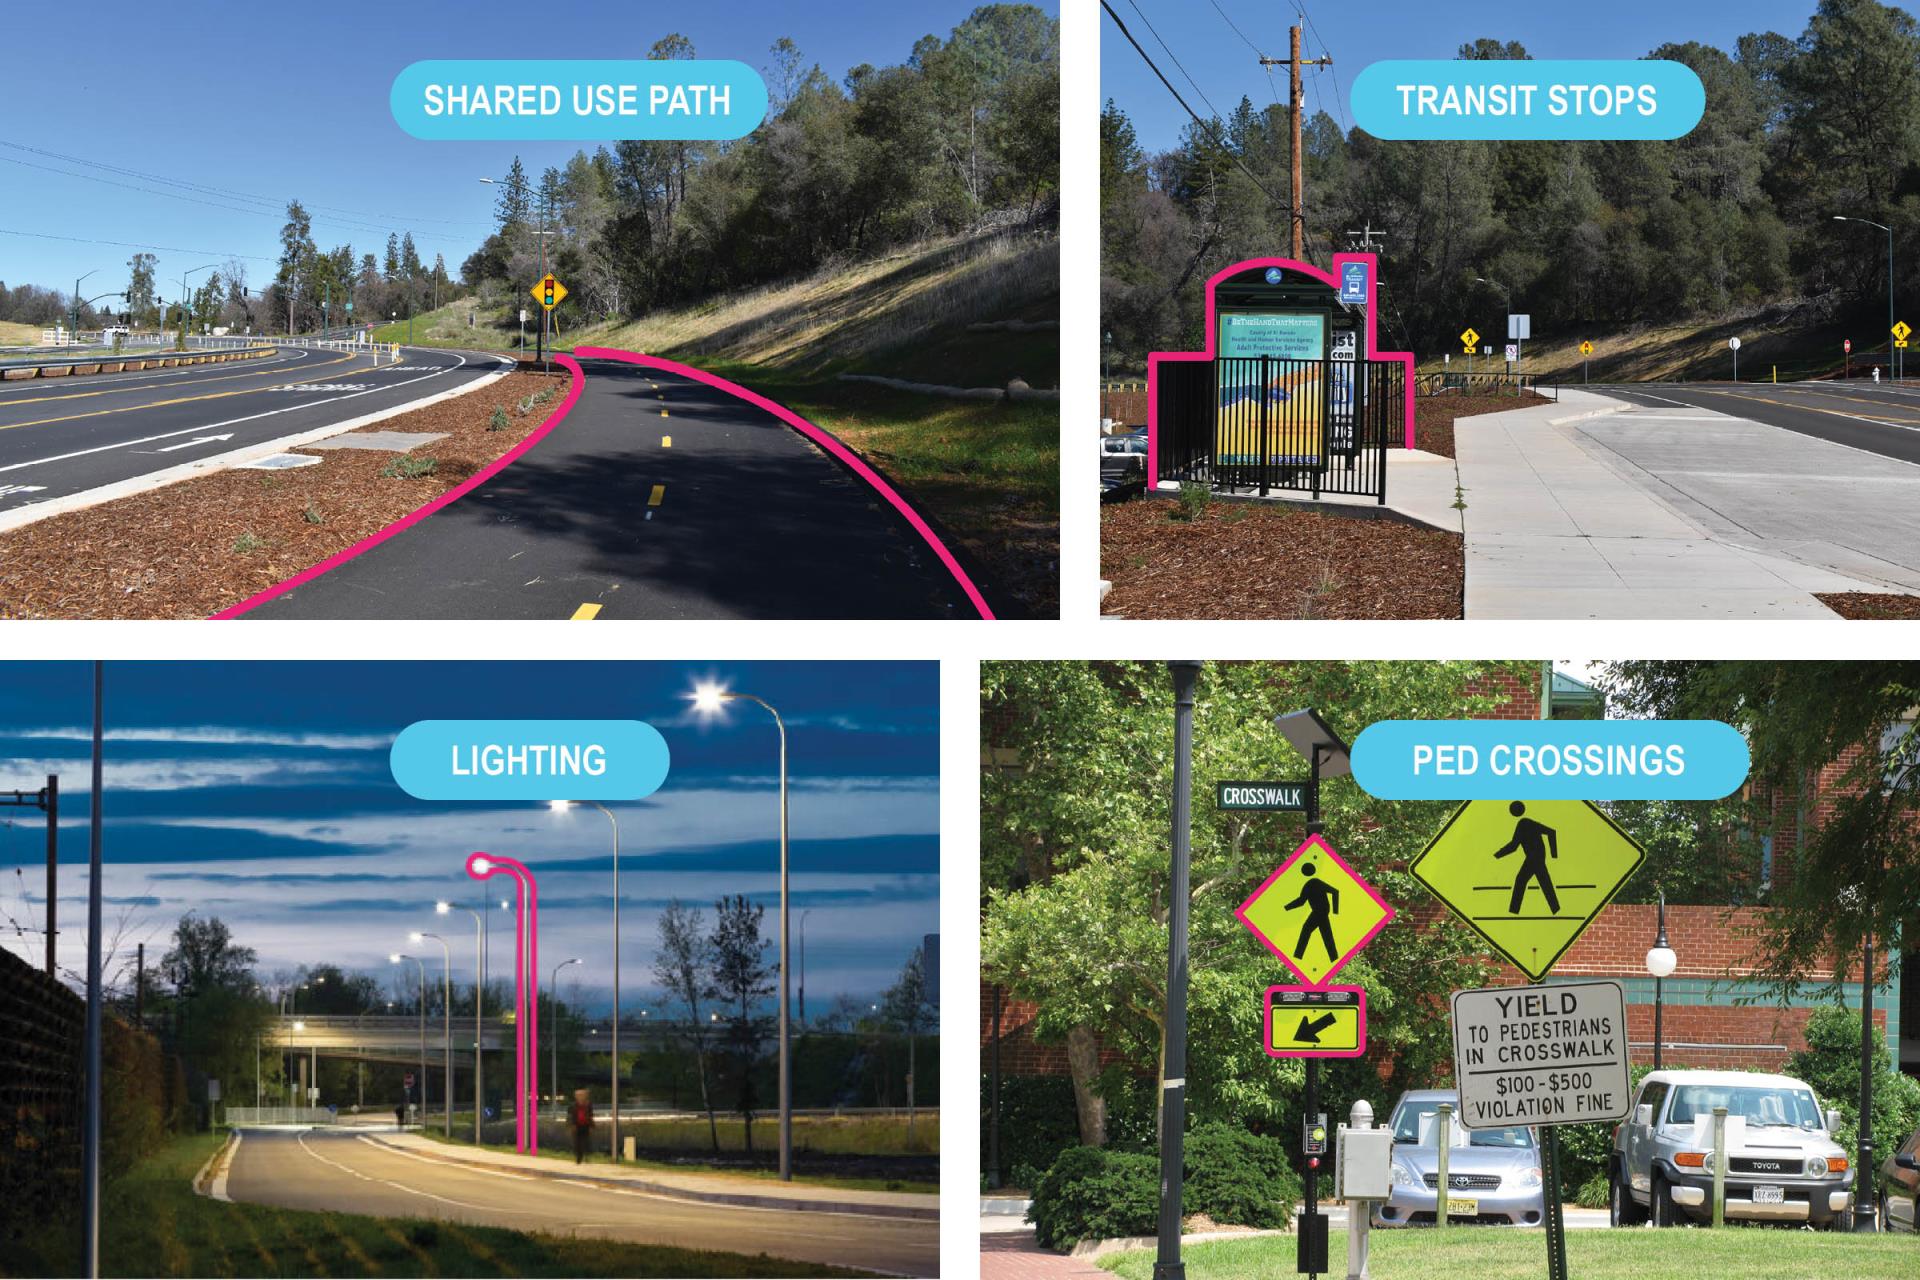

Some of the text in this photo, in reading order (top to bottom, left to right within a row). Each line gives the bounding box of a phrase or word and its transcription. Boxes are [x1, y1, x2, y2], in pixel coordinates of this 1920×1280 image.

[1224, 788, 1300, 806] CROSSWALK
[1496, 993, 1578, 1018] YIELD
[1469, 1018, 1611, 1044] TO PEDESTRIANS
[1466, 1039, 1615, 1065] IN CROSSWALK
[1476, 1093, 1614, 1119] VIOLATION FINE
